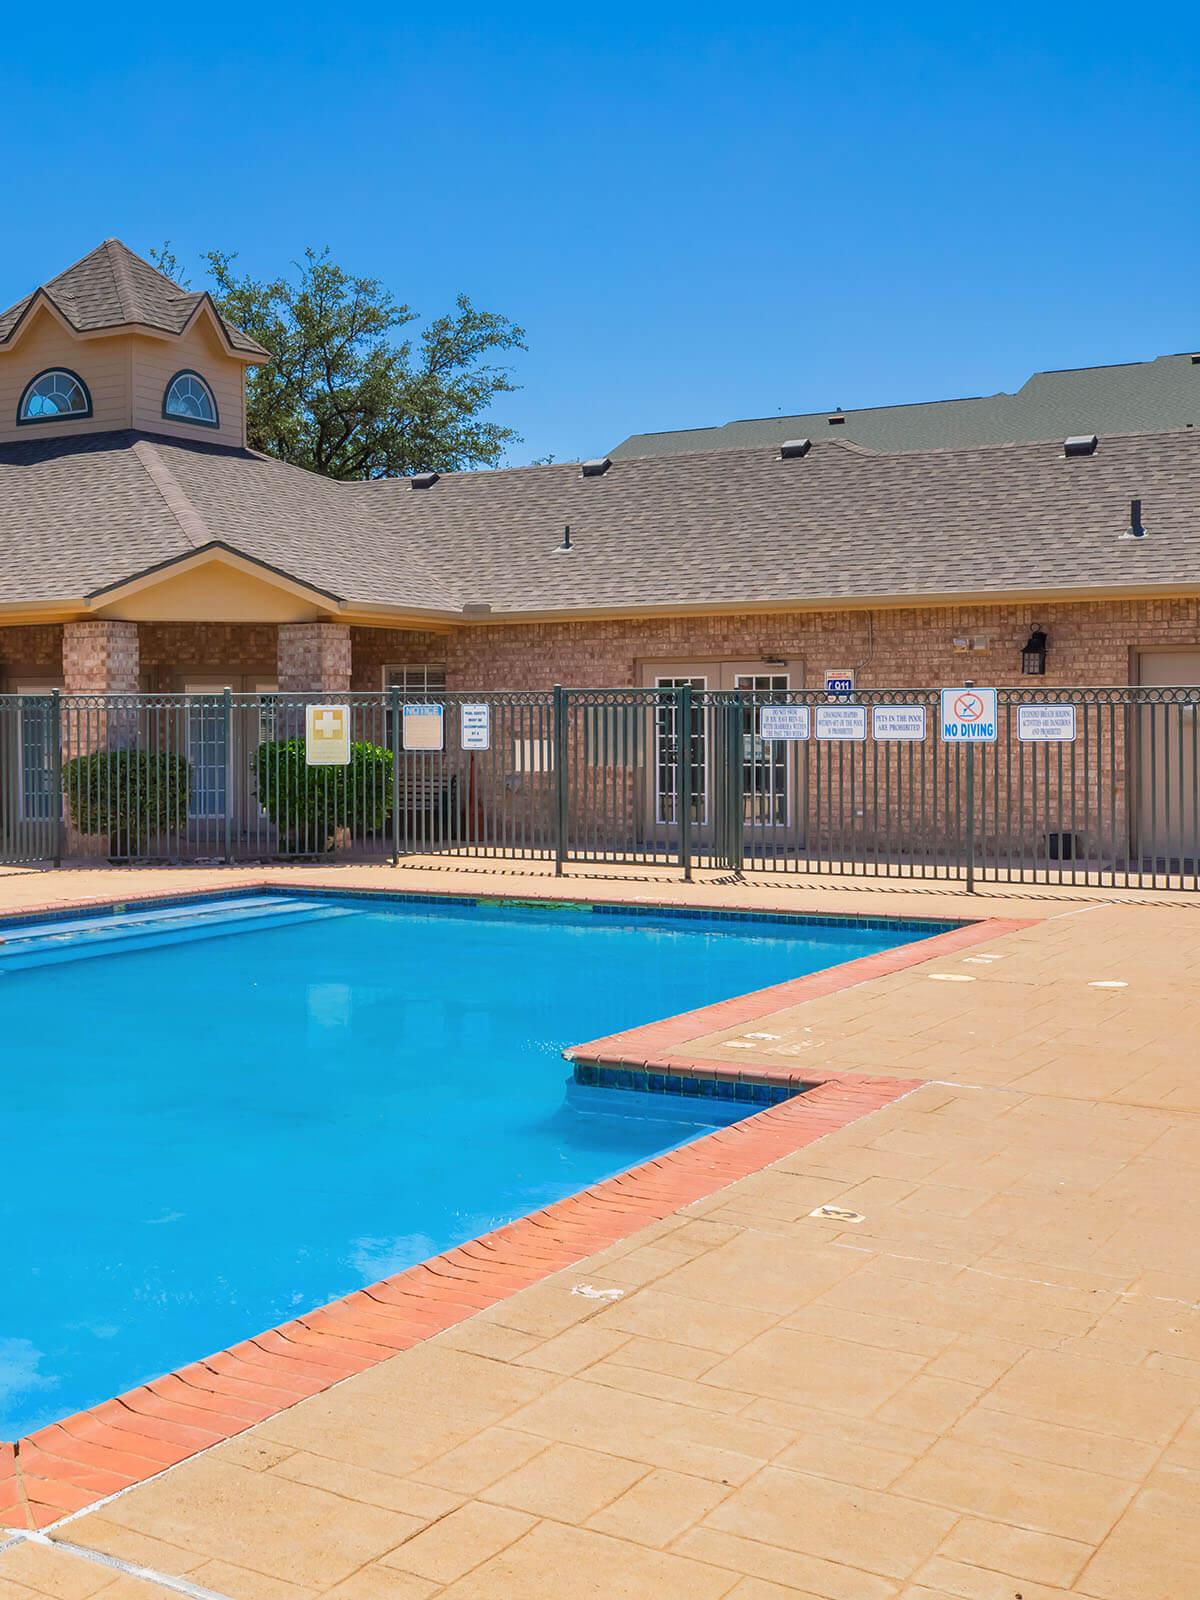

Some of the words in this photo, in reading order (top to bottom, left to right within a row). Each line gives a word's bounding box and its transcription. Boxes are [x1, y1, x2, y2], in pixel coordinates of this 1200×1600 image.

[834, 681, 849, 691] 911
[406, 706, 438, 716] NOTICE
[944, 723, 958, 736] NO
[960, 723, 993, 737] DIVING
